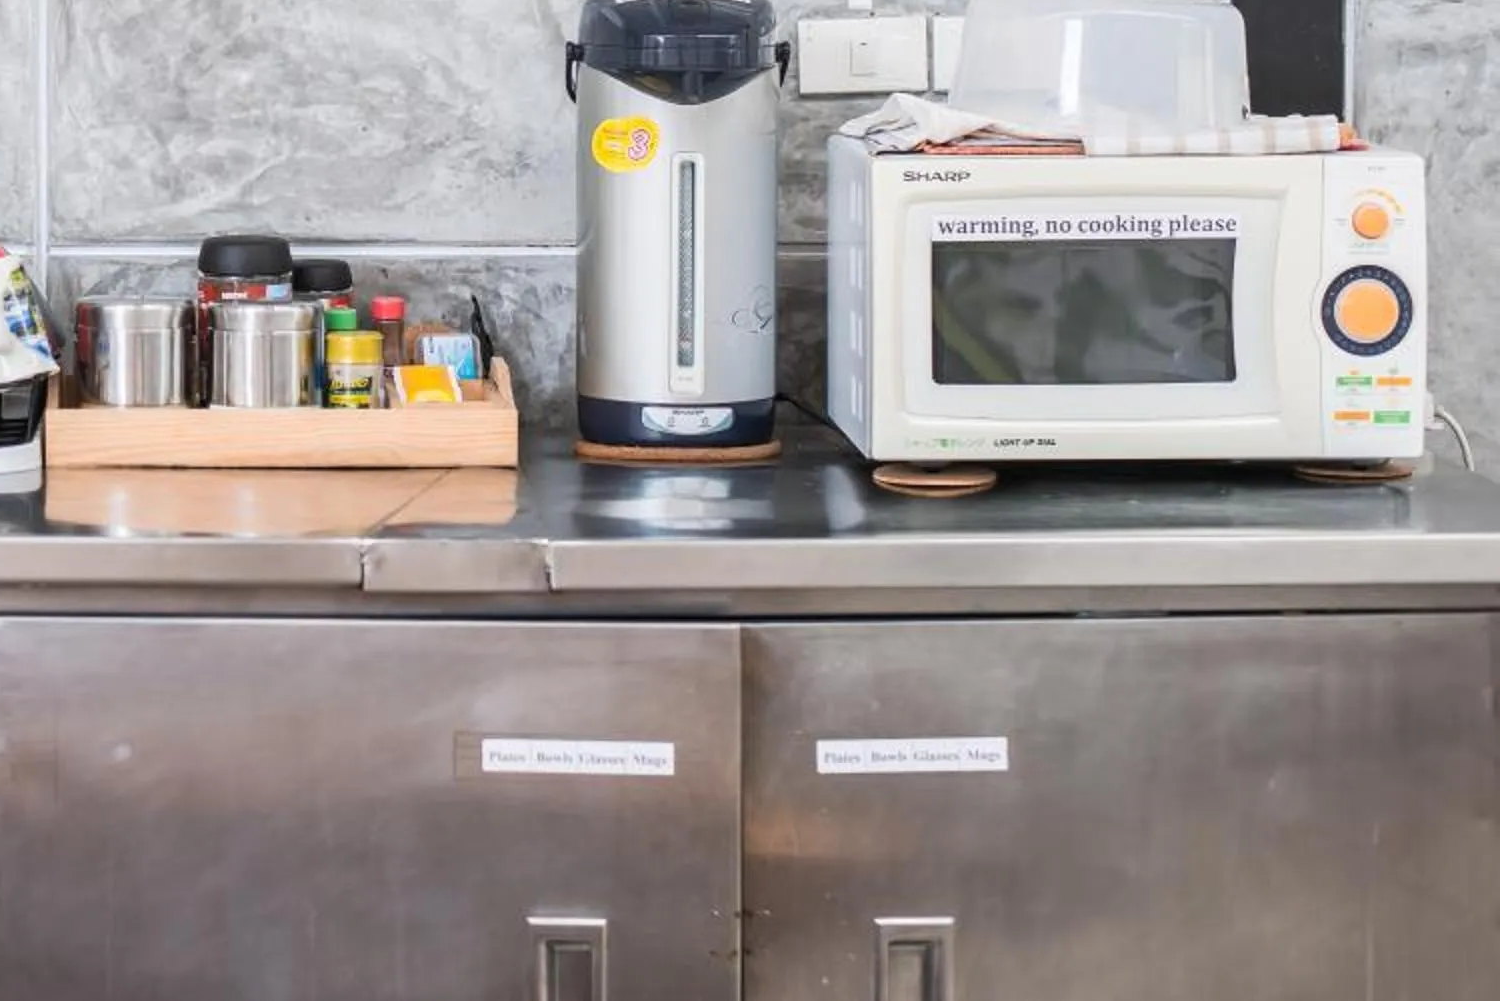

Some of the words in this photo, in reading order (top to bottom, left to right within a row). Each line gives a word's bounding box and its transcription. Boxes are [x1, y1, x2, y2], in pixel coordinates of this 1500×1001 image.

[628, 129, 651, 161] 3
[903, 170, 971, 183] SHARP
[938, 215, 1040, 237] warming,
[1045, 219, 1072, 234] no
[1077, 215, 1163, 237] cooking
[1168, 214, 1237, 236] please
[489, 751, 526, 763] Plates
[536, 751, 574, 764] Bowls
[633, 754, 668, 768] Mugs
[824, 751, 861, 764] Plates
[870, 750, 908, 762] Bowls
[913, 750, 961, 762] Glasses
[967, 748, 1001, 763] Mugs
